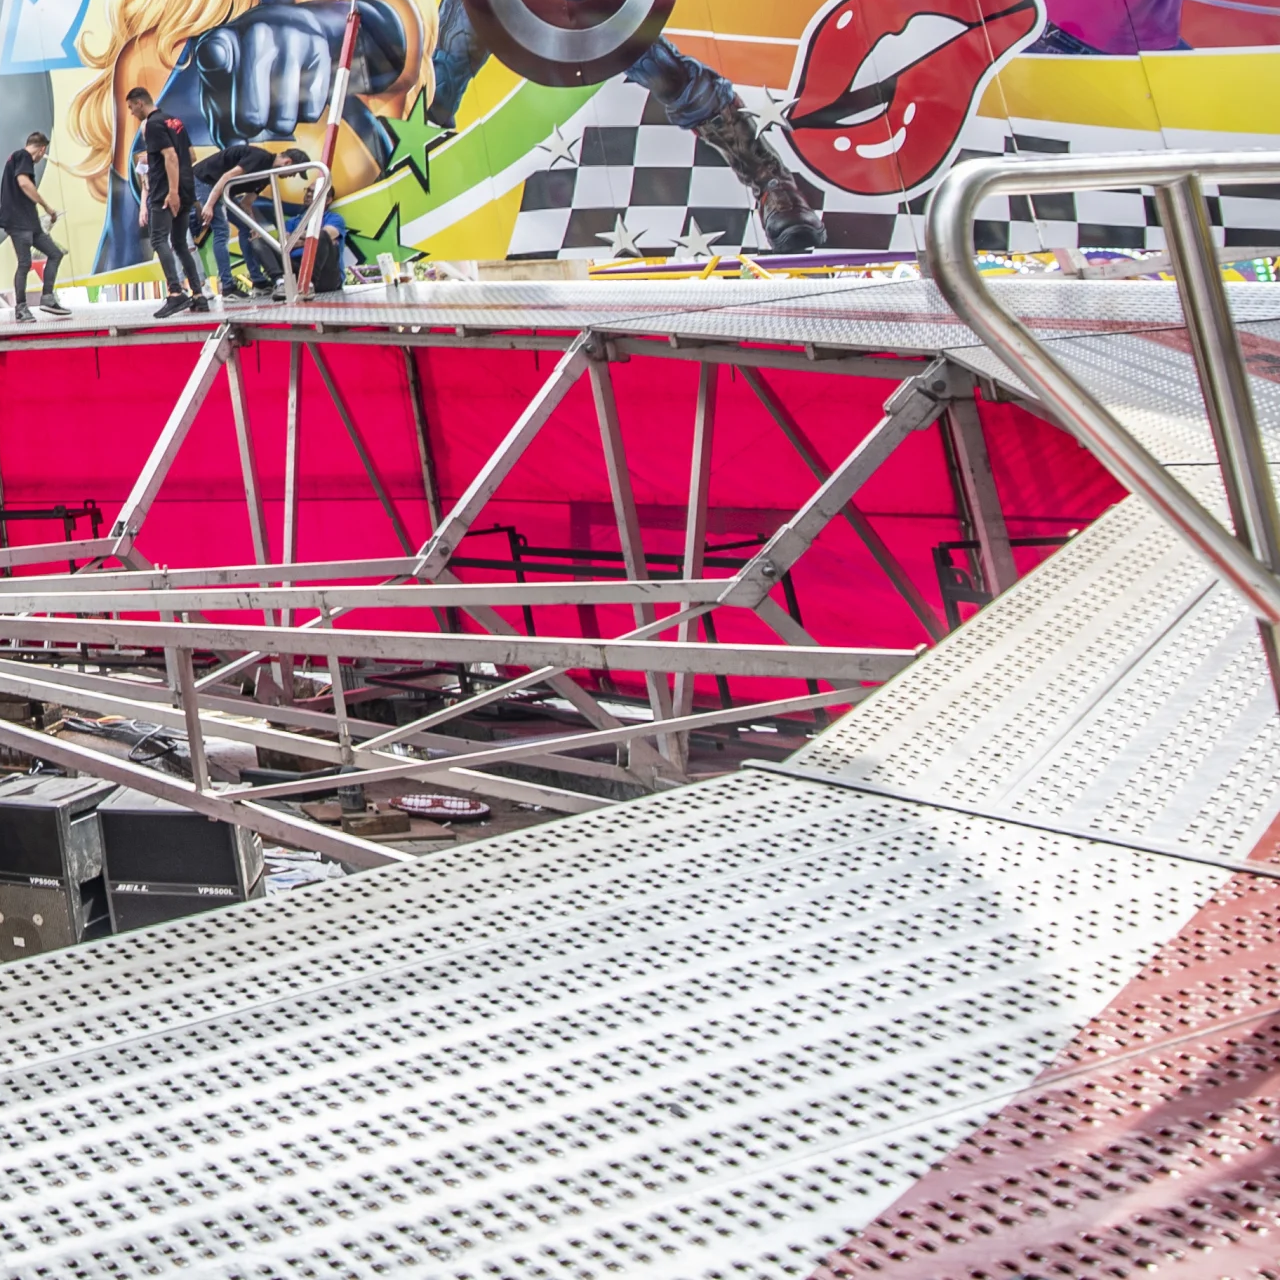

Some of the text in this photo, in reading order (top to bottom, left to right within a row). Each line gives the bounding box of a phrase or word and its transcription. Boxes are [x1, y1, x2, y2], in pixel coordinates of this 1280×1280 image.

[29, 877, 60, 887] VPS500L
[116, 883, 234, 896] BELL VPS500L
